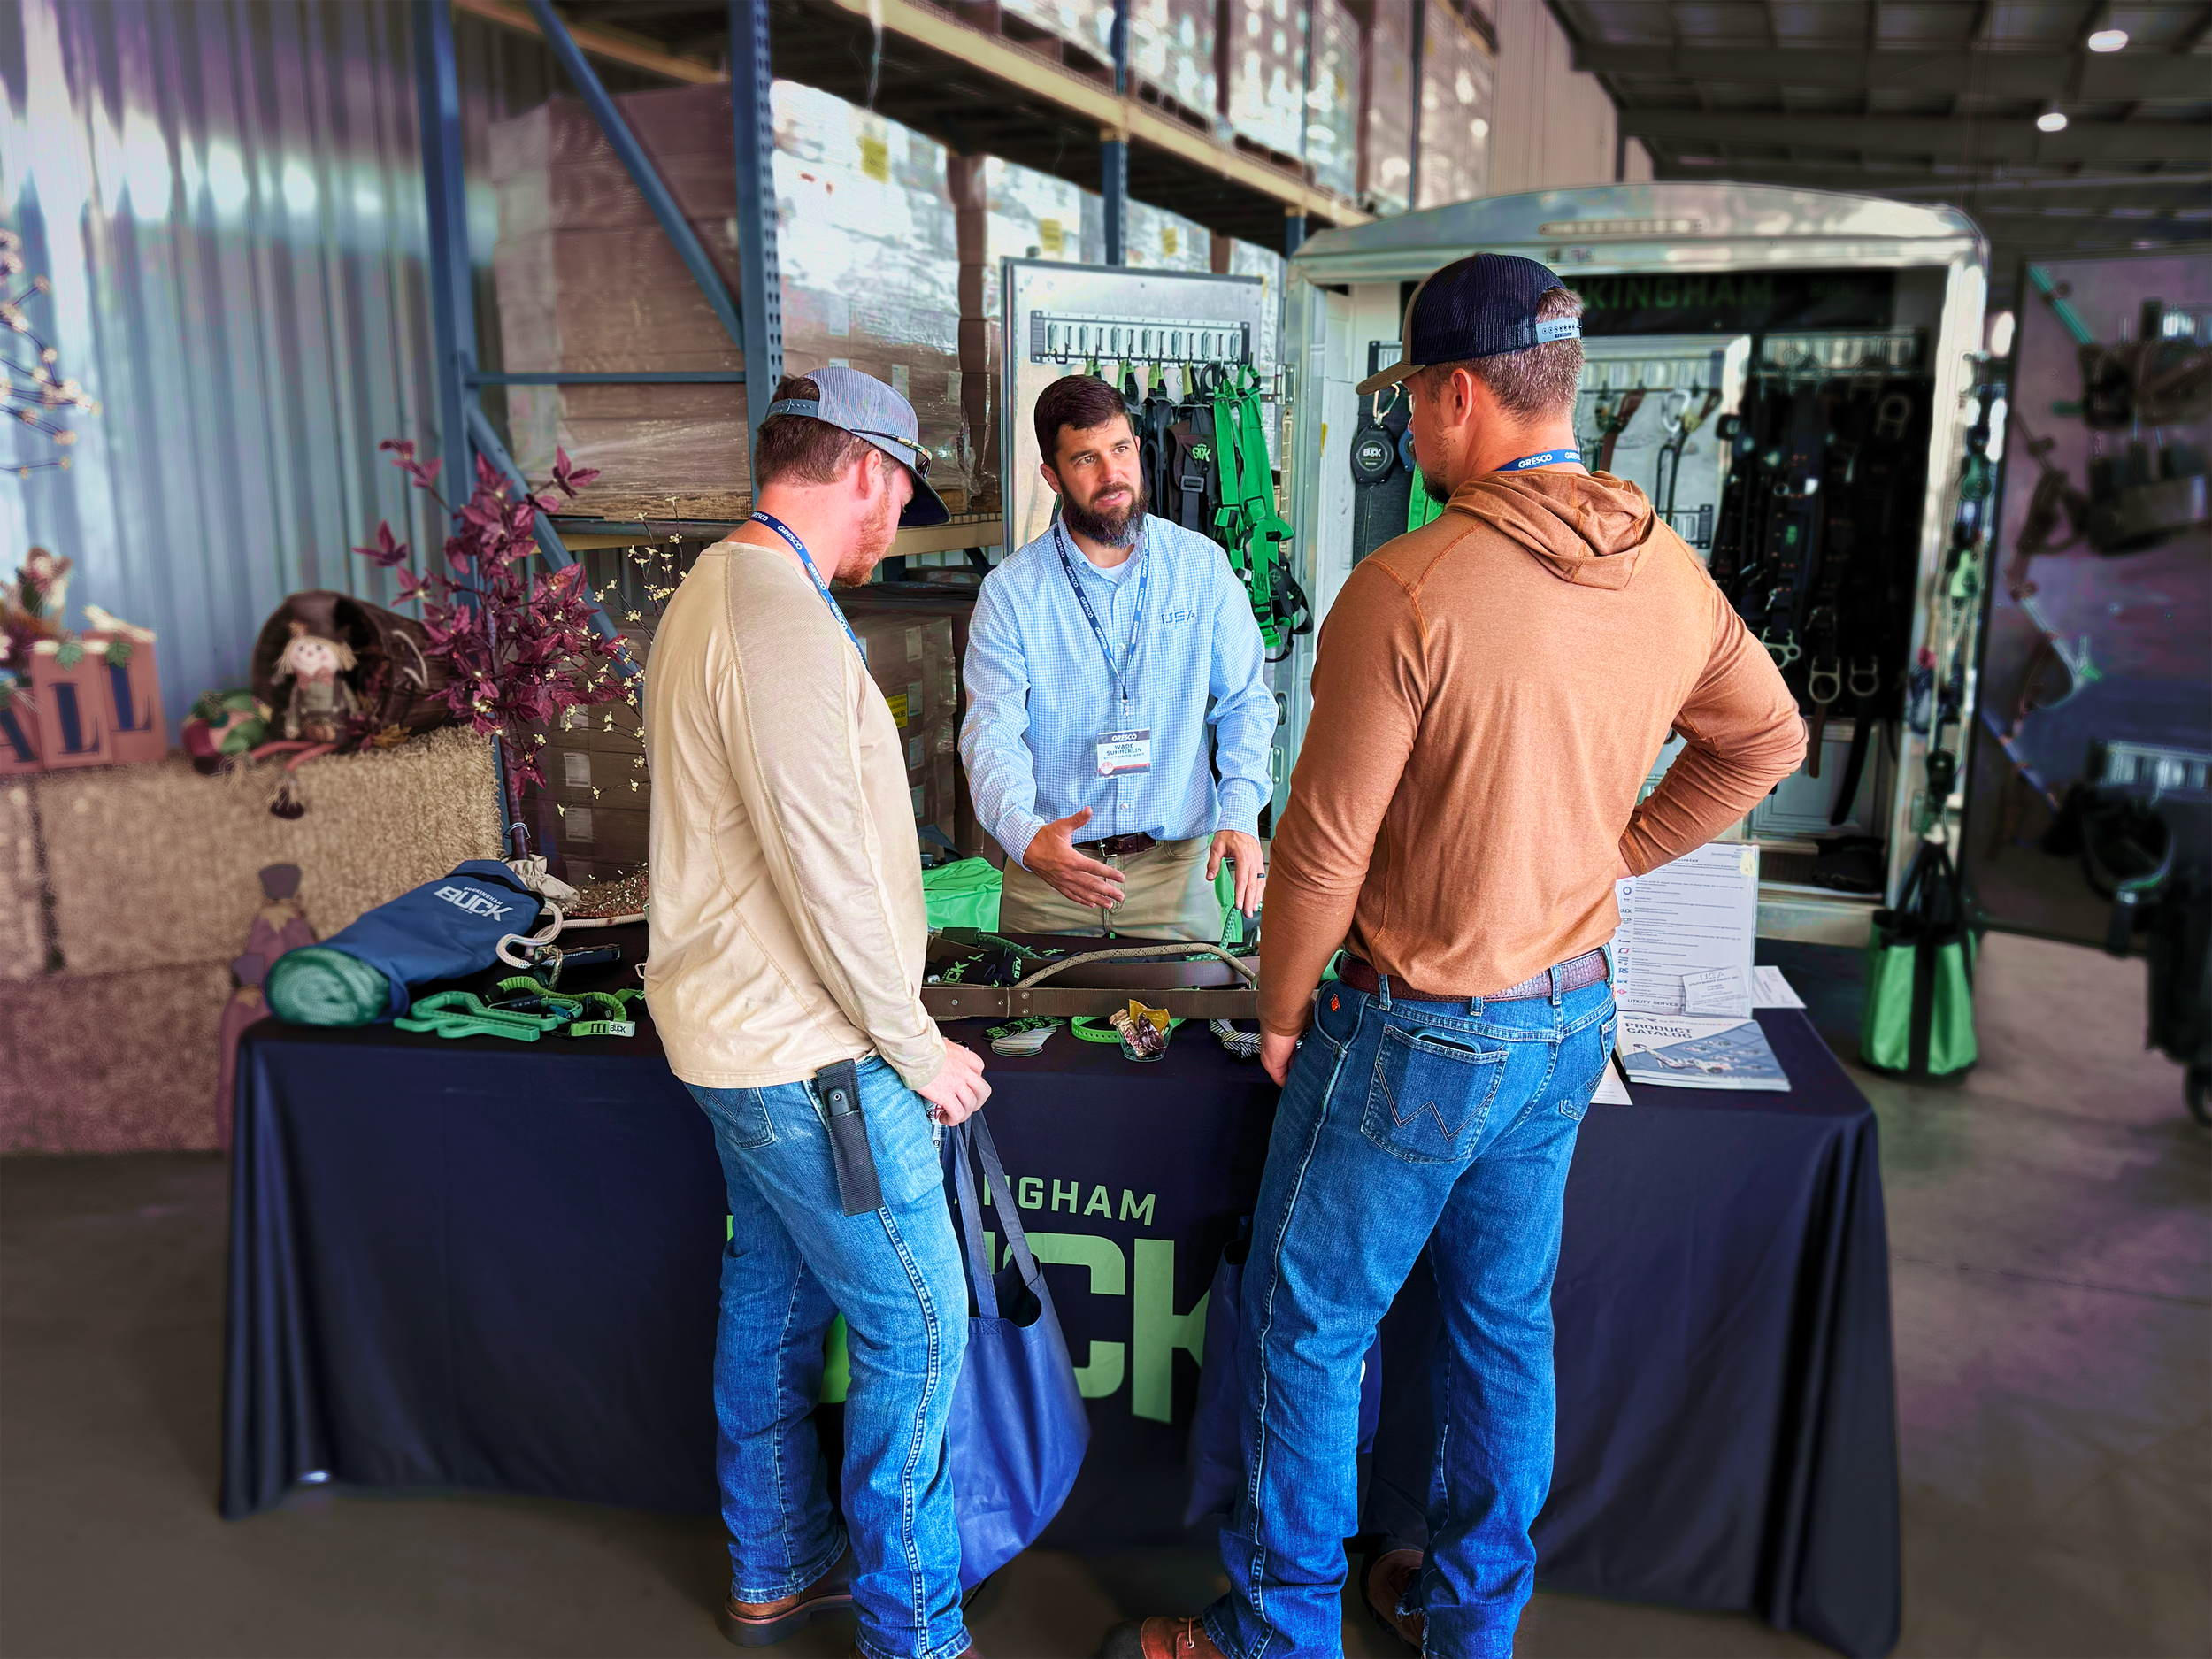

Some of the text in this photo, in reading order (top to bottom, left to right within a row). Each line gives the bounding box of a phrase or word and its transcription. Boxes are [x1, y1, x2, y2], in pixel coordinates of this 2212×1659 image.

[1363, 447, 1381, 457] BUCK
[1518, 454, 1553, 468] GRESCO
[777, 525, 803, 550] GRESCO
[807, 562, 826, 591] GRESCO
[831, 602, 848, 630] GRESCO
[434, 886, 513, 921] BUCK
[463, 887, 503, 905] BUCKINGHAM
[1625, 1022, 1692, 1033] PRODUCT
[1627, 1028, 1692, 1039] CATALOG
